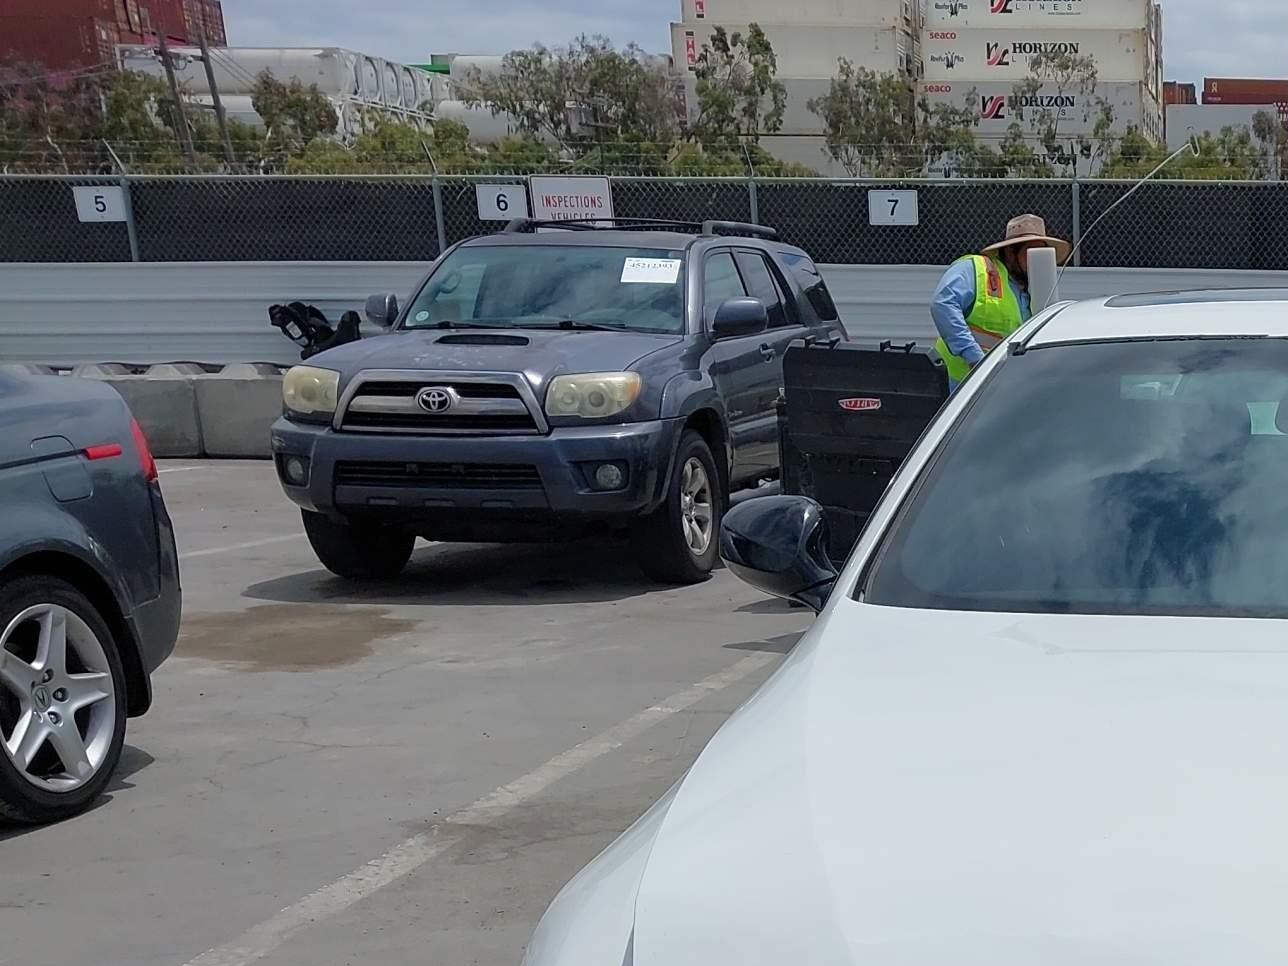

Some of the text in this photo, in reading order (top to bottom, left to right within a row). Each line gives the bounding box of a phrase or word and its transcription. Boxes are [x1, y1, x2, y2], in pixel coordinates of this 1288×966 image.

[929, 32, 957, 40] seaco
[1011, 42, 1080, 54] HORIZON
[924, 84, 952, 93] seaco
[94, 195, 107, 213] 5
[496, 193, 509, 212] 6
[541, 194, 603, 209] INSPECTIONS
[887, 199, 899, 217] 7
